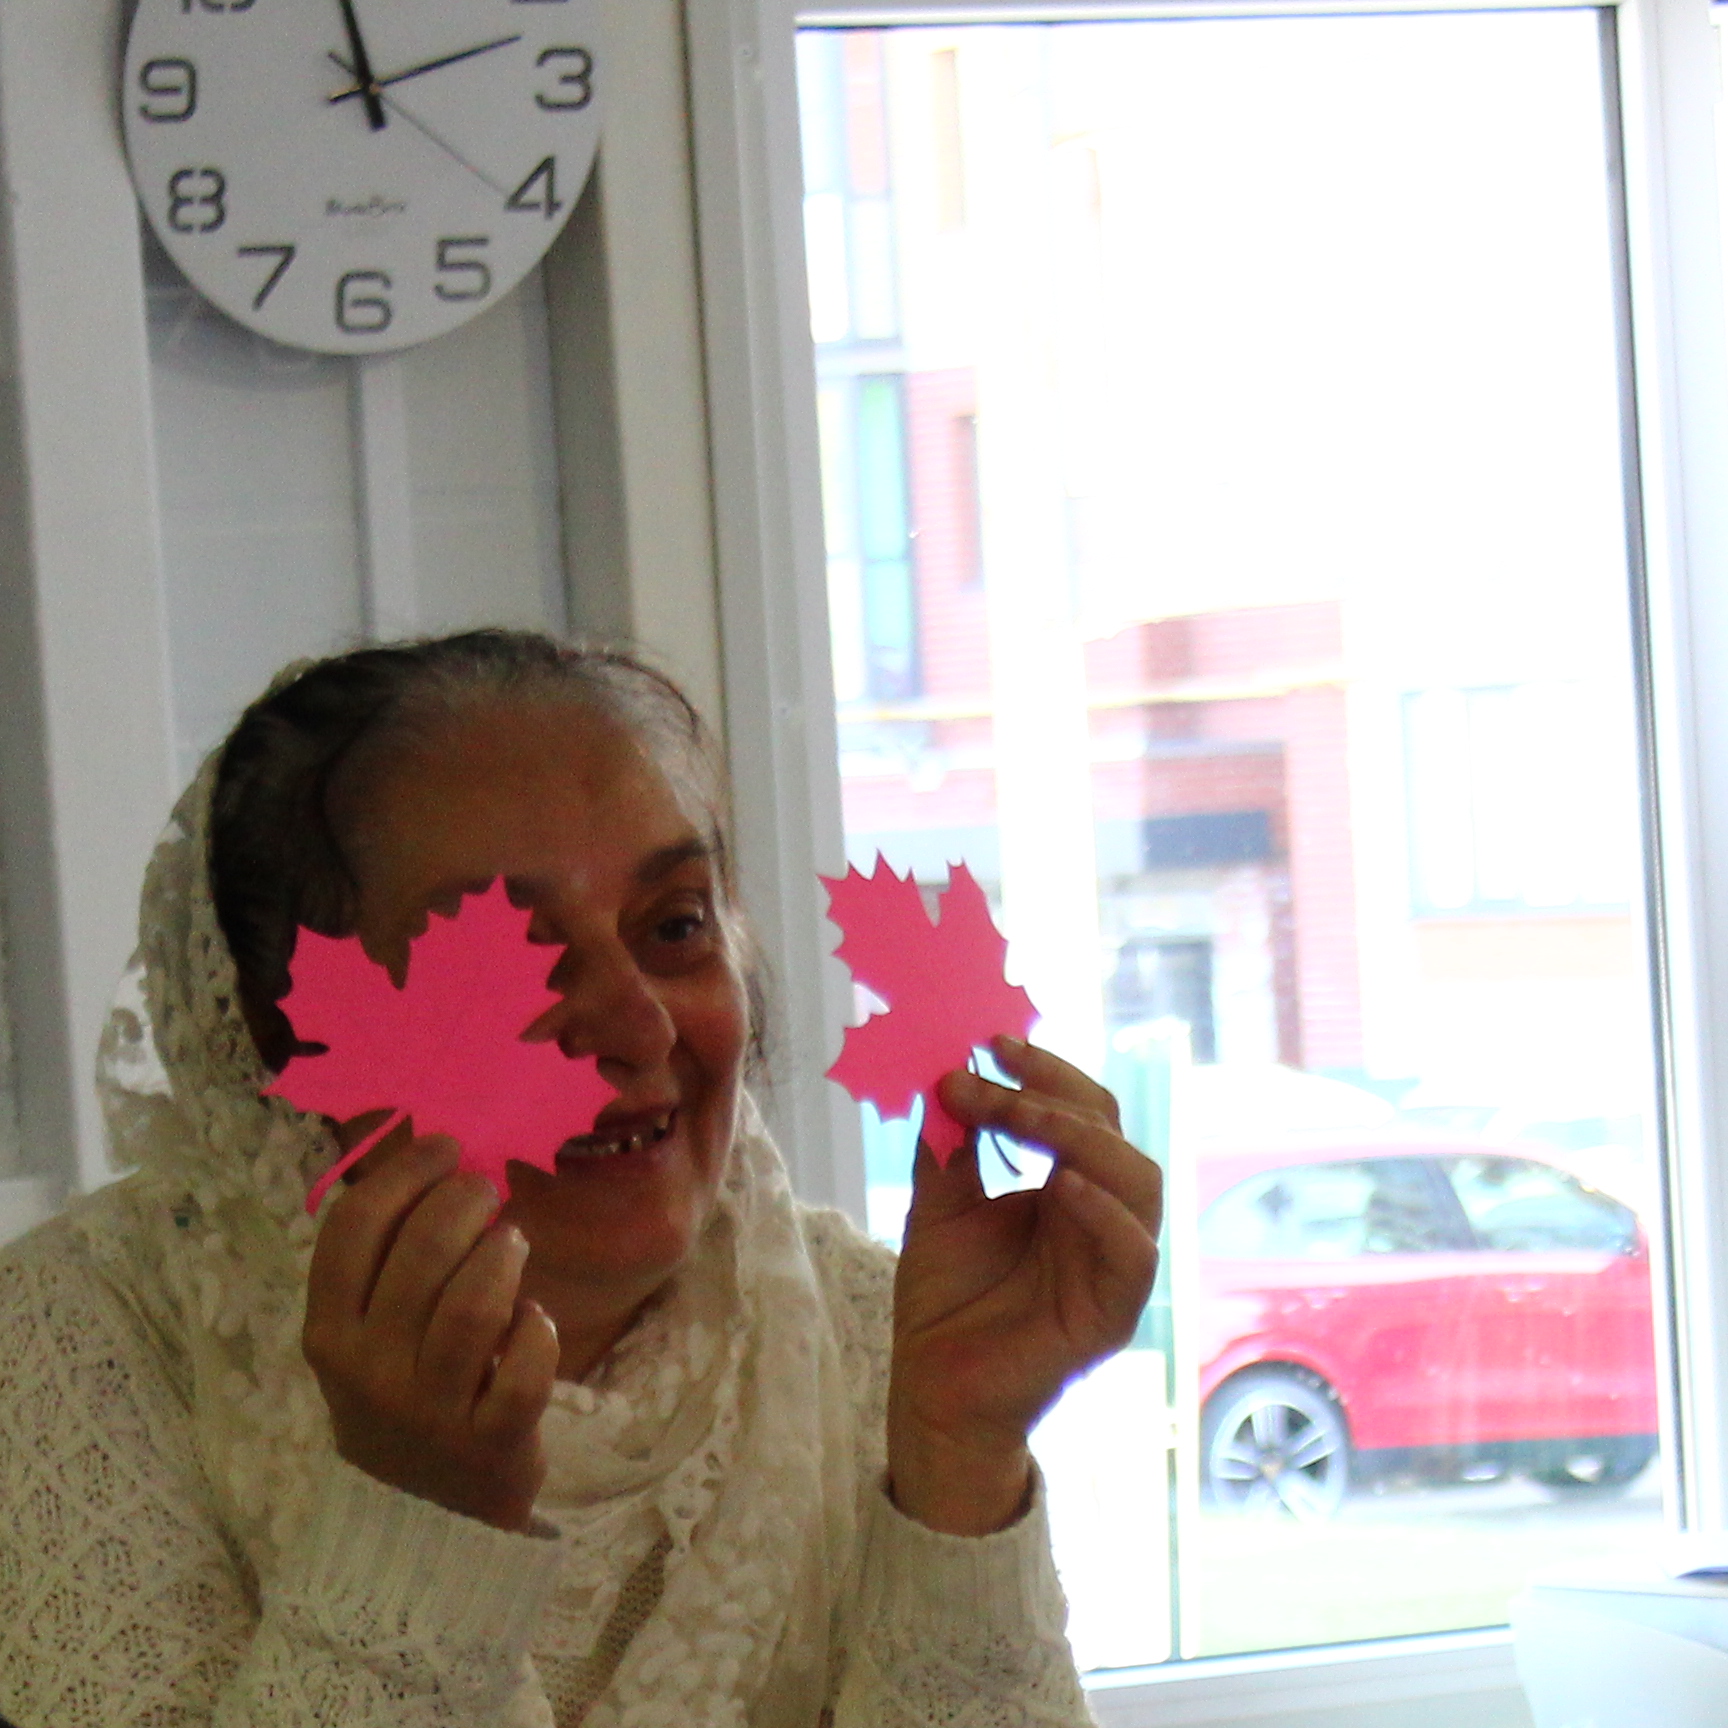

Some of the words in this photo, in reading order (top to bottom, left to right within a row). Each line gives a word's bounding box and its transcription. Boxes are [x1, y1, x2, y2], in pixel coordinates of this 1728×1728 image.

[139, 57, 198, 123] 9
[534, 46, 594, 112] 3
[168, 167, 227, 233] 8
[504, 155, 562, 220] 4
[237, 243, 296, 310] 7
[335, 270, 392, 333] 6
[434, 236, 491, 301] 5
